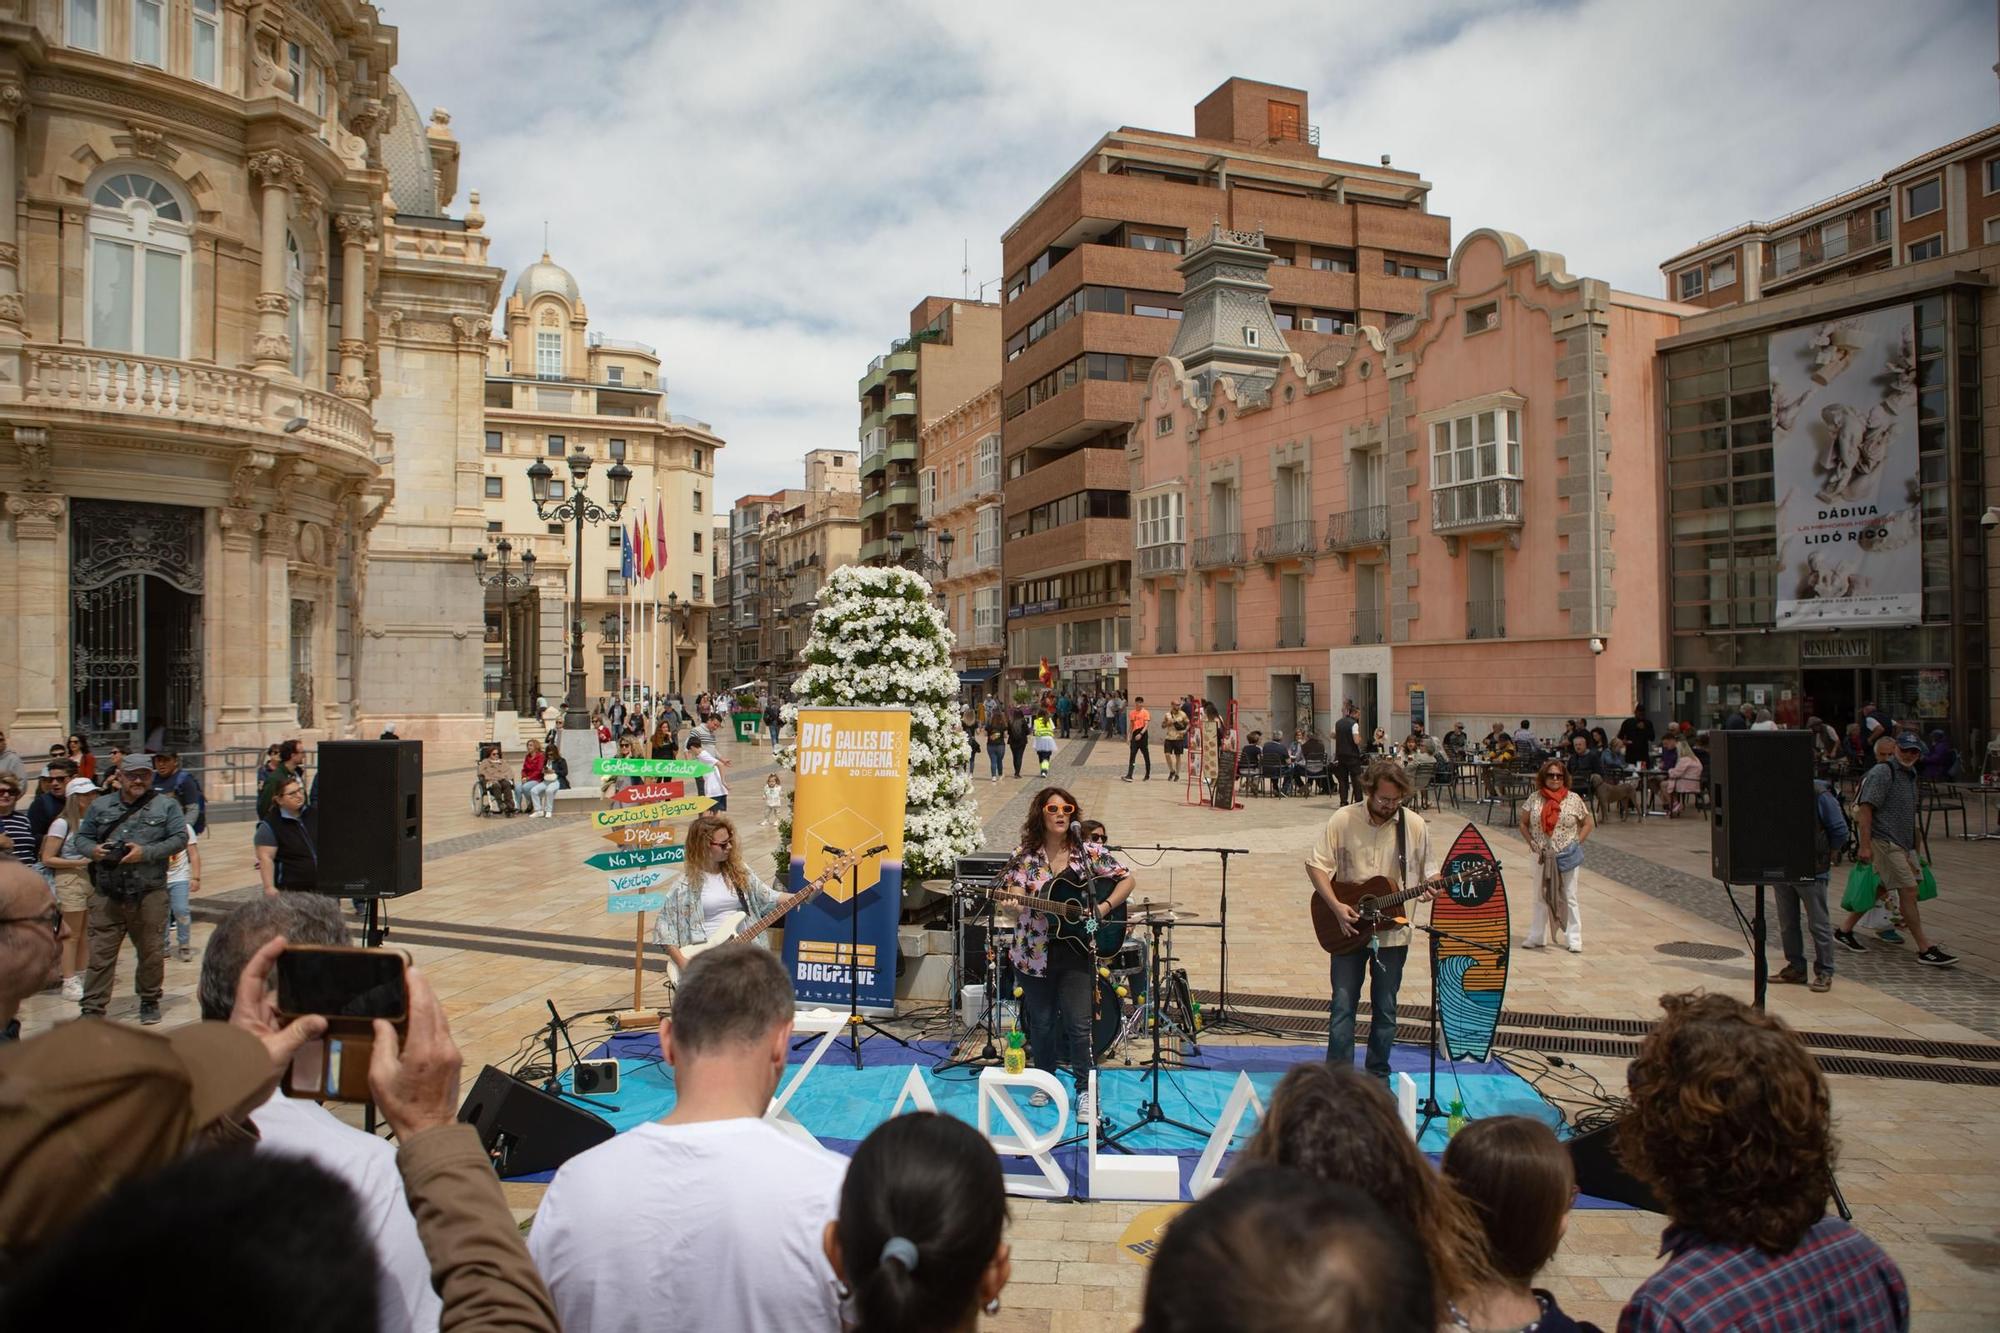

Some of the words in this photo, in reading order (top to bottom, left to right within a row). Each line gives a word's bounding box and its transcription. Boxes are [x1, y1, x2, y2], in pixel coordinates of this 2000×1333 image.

[1818, 505, 1878, 520] DÁDIVA
[1805, 530, 1842, 544] LIDÓ
[1848, 528, 1889, 542] RICO
[1804, 638, 1869, 656] RESTAURANTE
[802, 722, 833, 748] BIG
[836, 731, 878, 750] CALLES
[880, 731, 895, 750] DE
[601, 760, 637, 773] Golpe
[640, 761, 653, 773] de
[655, 761, 698, 774] Estado
[800, 751, 832, 776] UP!
[834, 751, 893, 768] CARTAGENA
[849, 769, 860, 777] 20
[861, 769, 872, 777] DE
[874, 769, 900, 777] ABRIL
[628, 786, 673, 800] Julia
[661, 801, 698, 816] Pegar
[608, 854, 626, 867] No
[631, 852, 646, 864] Me
[797, 962, 875, 985] BIGUP.LVE
